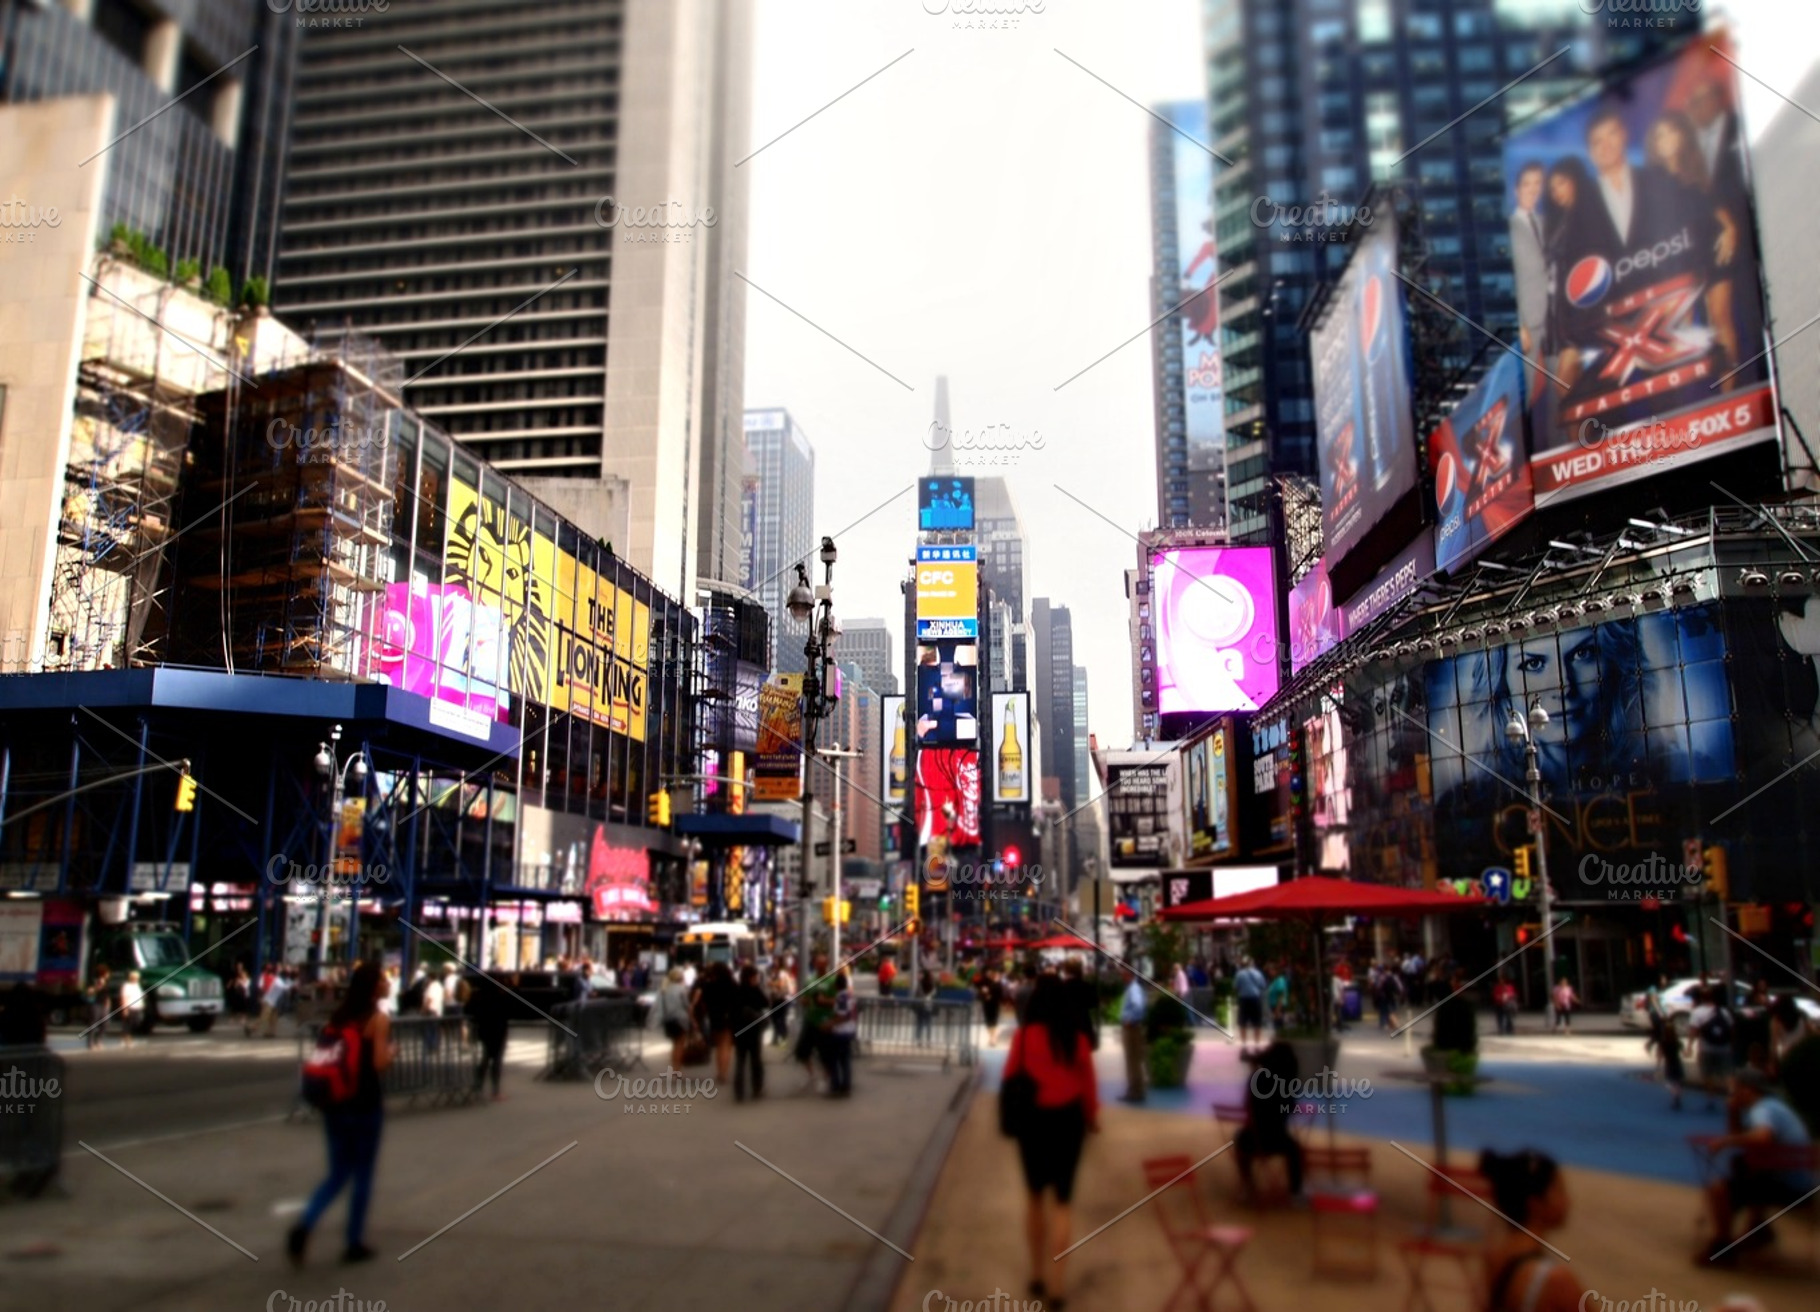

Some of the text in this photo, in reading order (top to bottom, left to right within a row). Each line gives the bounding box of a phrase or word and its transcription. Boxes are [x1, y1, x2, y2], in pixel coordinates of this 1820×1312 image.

[1613, 228, 1692, 282] pepsi
[1606, 289, 1654, 315] THE
[1575, 363, 1707, 417] FACTOR
[1551, 452, 1602, 482] WED
[1688, 410, 1731, 443] FOX
[1735, 404, 1751, 427] 5
[1467, 471, 1512, 517] FACTOR
[740, 500, 753, 581] TIMES
[1440, 512, 1462, 543] pepsi
[920, 570, 954, 585] CFC
[1348, 598, 1369, 630] WHERE
[1369, 577, 1396, 612] THERE'S
[1395, 558, 1417, 592] PEPSI
[588, 597, 615, 635] THE
[930, 620, 964, 630] XINHUA
[556, 618, 600, 688] LION
[602, 644, 642, 707] KING
[1254, 769, 1275, 794] PARK
[1571, 773, 1638, 796] HOPE
[1493, 785, 1661, 857] ONCE
